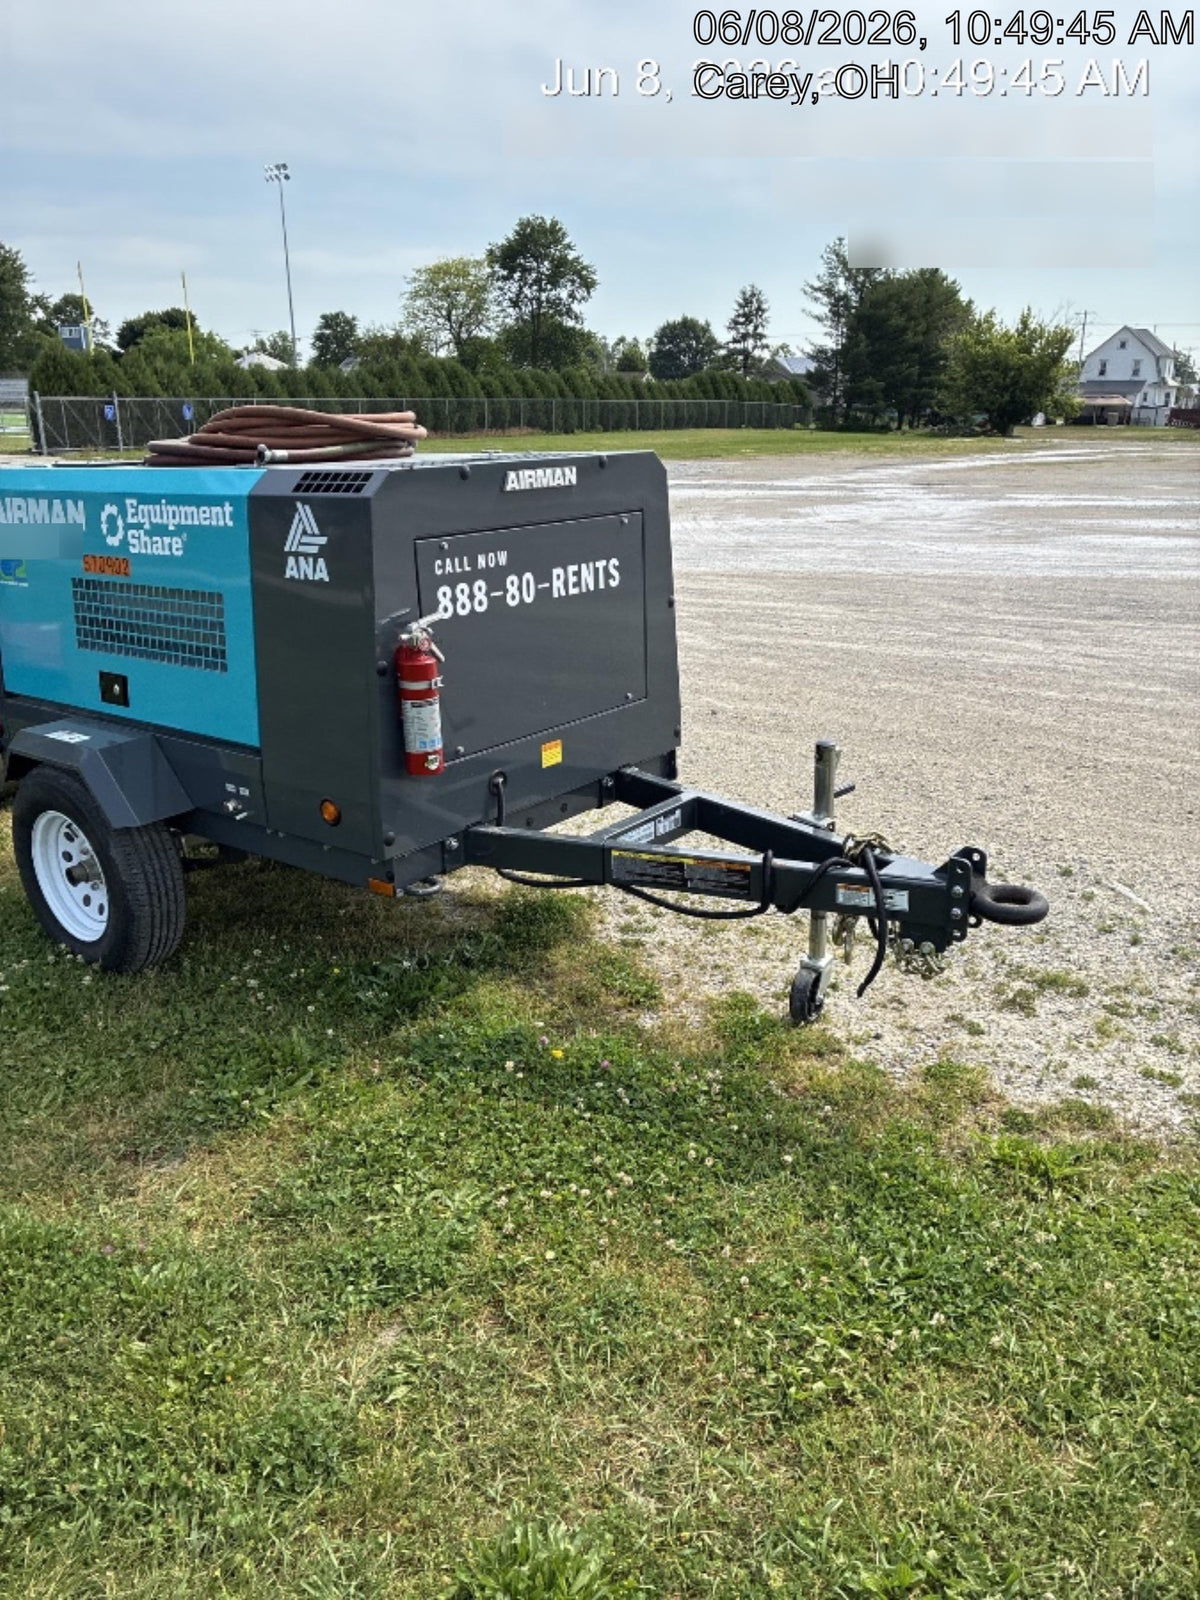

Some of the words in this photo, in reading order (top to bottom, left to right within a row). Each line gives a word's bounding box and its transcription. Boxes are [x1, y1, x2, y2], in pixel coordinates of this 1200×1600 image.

[505, 466, 577, 491] AIRMAN
[125, 499, 234, 530] Equipment
[284, 556, 330, 582] ANA
[435, 556, 471, 575] CALL
[477, 551, 508, 570] NOW
[437, 558, 621, 619] 888-80-RENTS
